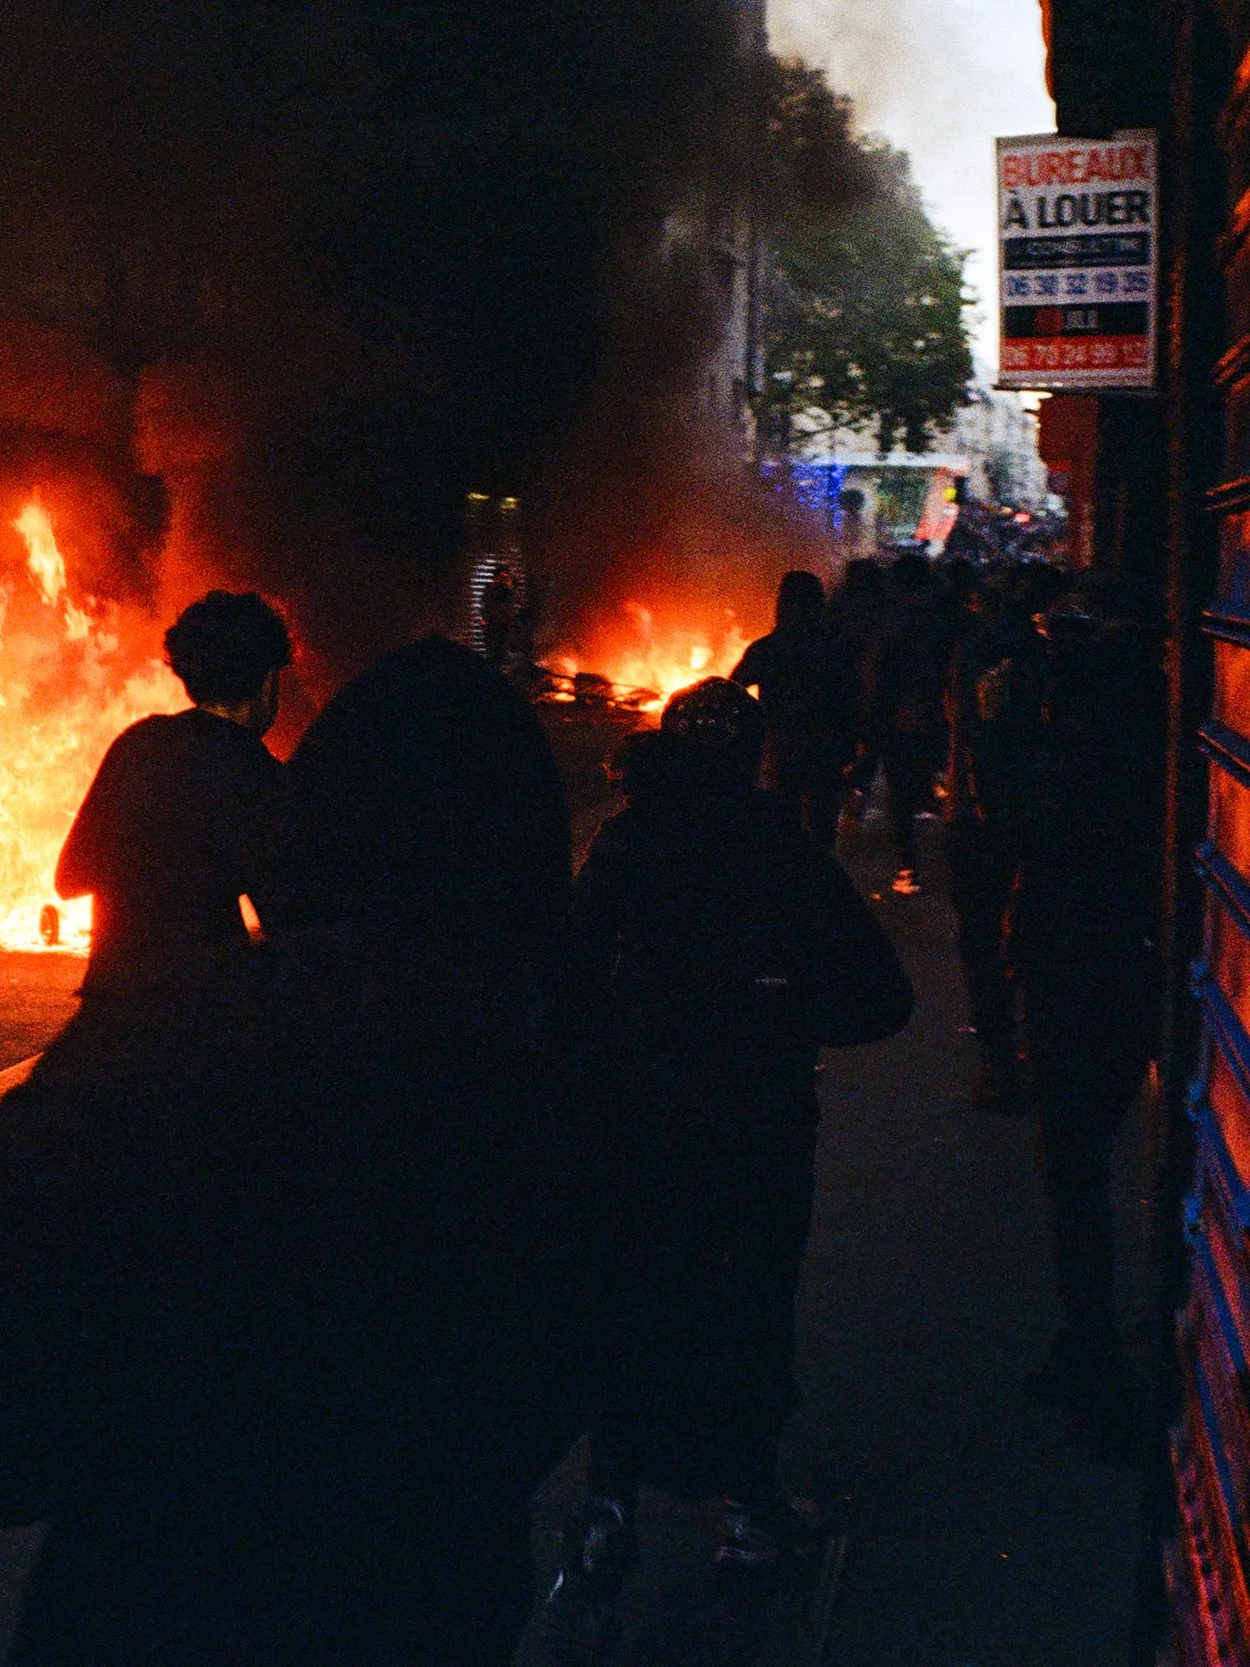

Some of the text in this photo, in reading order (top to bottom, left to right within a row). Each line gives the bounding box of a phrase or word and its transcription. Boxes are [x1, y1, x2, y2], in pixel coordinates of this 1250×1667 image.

[1003, 149, 1150, 188] BUREAUX
[1004, 190, 1150, 230] À LOUER
